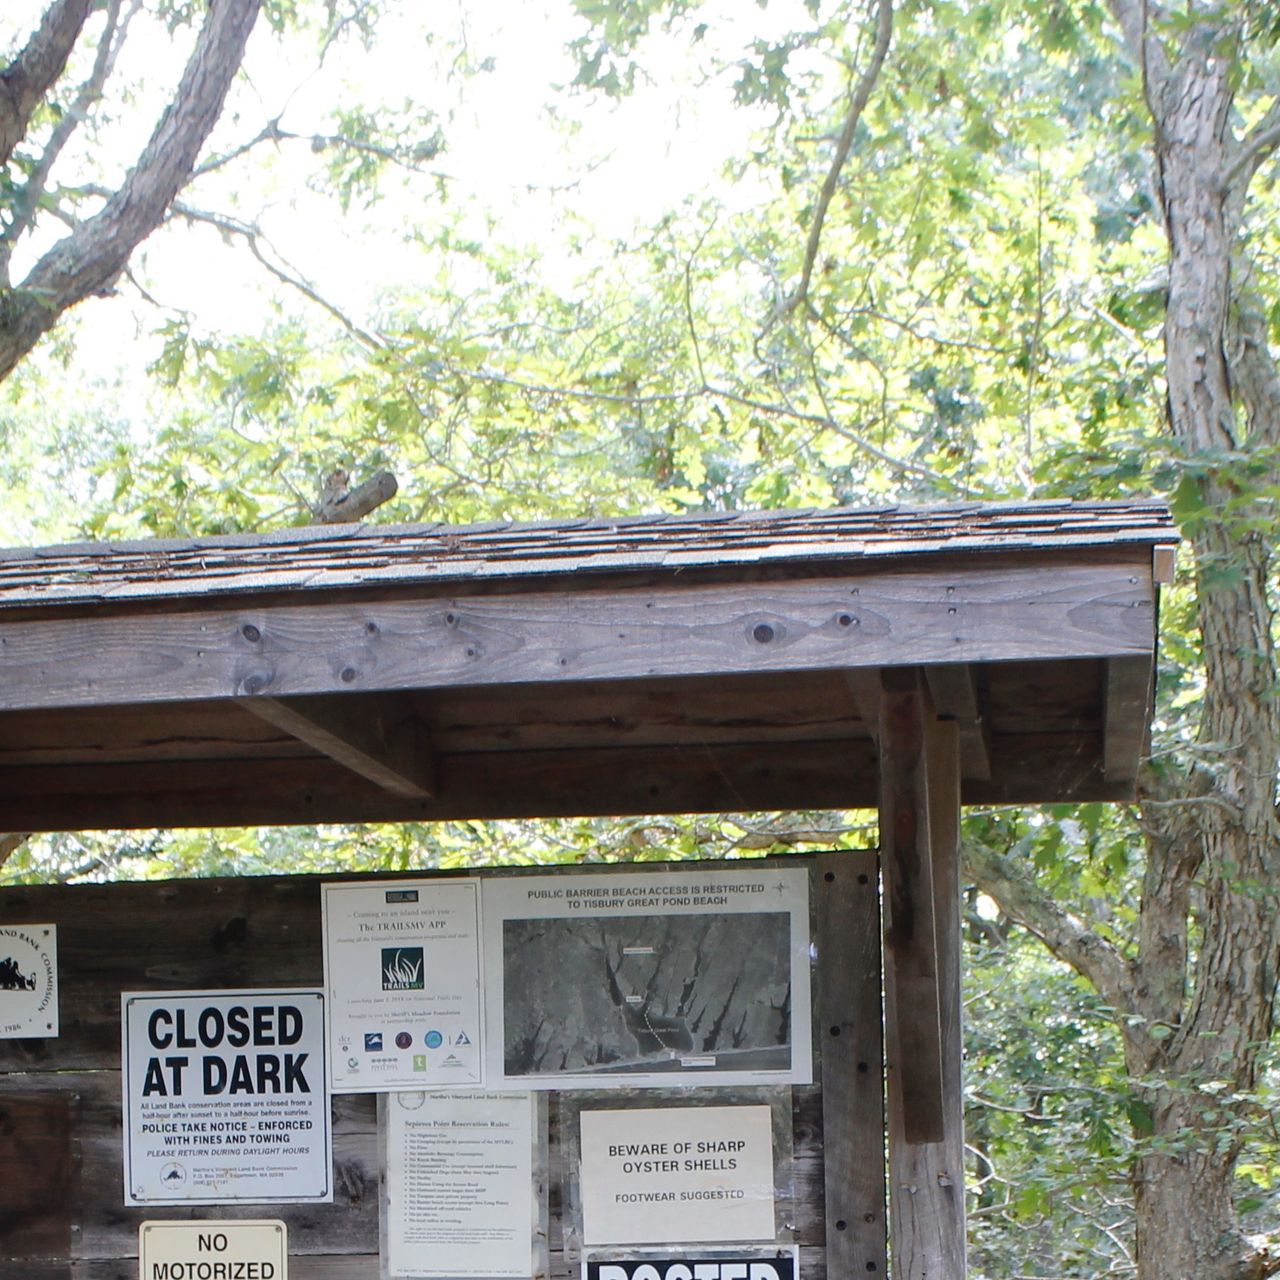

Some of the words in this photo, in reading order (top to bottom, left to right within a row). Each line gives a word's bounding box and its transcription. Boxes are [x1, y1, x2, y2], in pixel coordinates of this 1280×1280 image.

[527, 890, 564, 899] PUBLIC
[565, 888, 610, 898] BARRIER
[612, 887, 647, 897] BEACH
[648, 886, 689, 896] ACCESS
[691, 886, 701, 895] IS
[702, 884, 765, 894] RESTRICTED
[568, 901, 581, 909] TO
[584, 899, 624, 908] TISBURY
[627, 899, 659, 907] GREAT
[662, 898, 691, 906] POND
[692, 897, 728, 906] BEACH
[19, 933, 40, 951] BANK
[38, 953, 53, 1013] COMMISSION
[148, 1006, 303, 1049] CLOSED
[142, 1056, 188, 1097] AT
[203, 1054, 311, 1095] DARK
[151, 1102, 168, 1110] Land
[188, 1101, 232, 1109] conservation
[266, 1100, 289, 1108] closed
[142, 1111, 171, 1119] half-hour
[214, 1110, 223, 1118] to
[283, 1109, 310, 1117] sunrise.
[142, 1123, 178, 1133] POLICE
[182, 1123, 207, 1132] TAKE
[210, 1122, 247, 1131] NOTICE
[258, 1121, 313, 1130] ENFORCED
[164, 1136, 190, 1145] WITH
[193, 1135, 222, 1144] FINES
[225, 1135, 247, 1144] AND
[249, 1134, 290, 1143] TOWING
[177, 1149, 210, 1157] RETURN
[211, 1148, 242, 1156] DURING
[282, 1147, 310, 1155] HOURS
[609, 1142, 668, 1157] BEWARE
[673, 1141, 691, 1155] OF
[697, 1140, 746, 1154] SHARP
[623, 1158, 679, 1173] OYSTER
[684, 1157, 737, 1172] SHELLS
[615, 1192, 676, 1203] FOOTWEAR
[680, 1190, 745, 1202] SUGGESTED
[198, 1233, 228, 1252] NO
[153, 1262, 275, 1280] MOTORIZED
